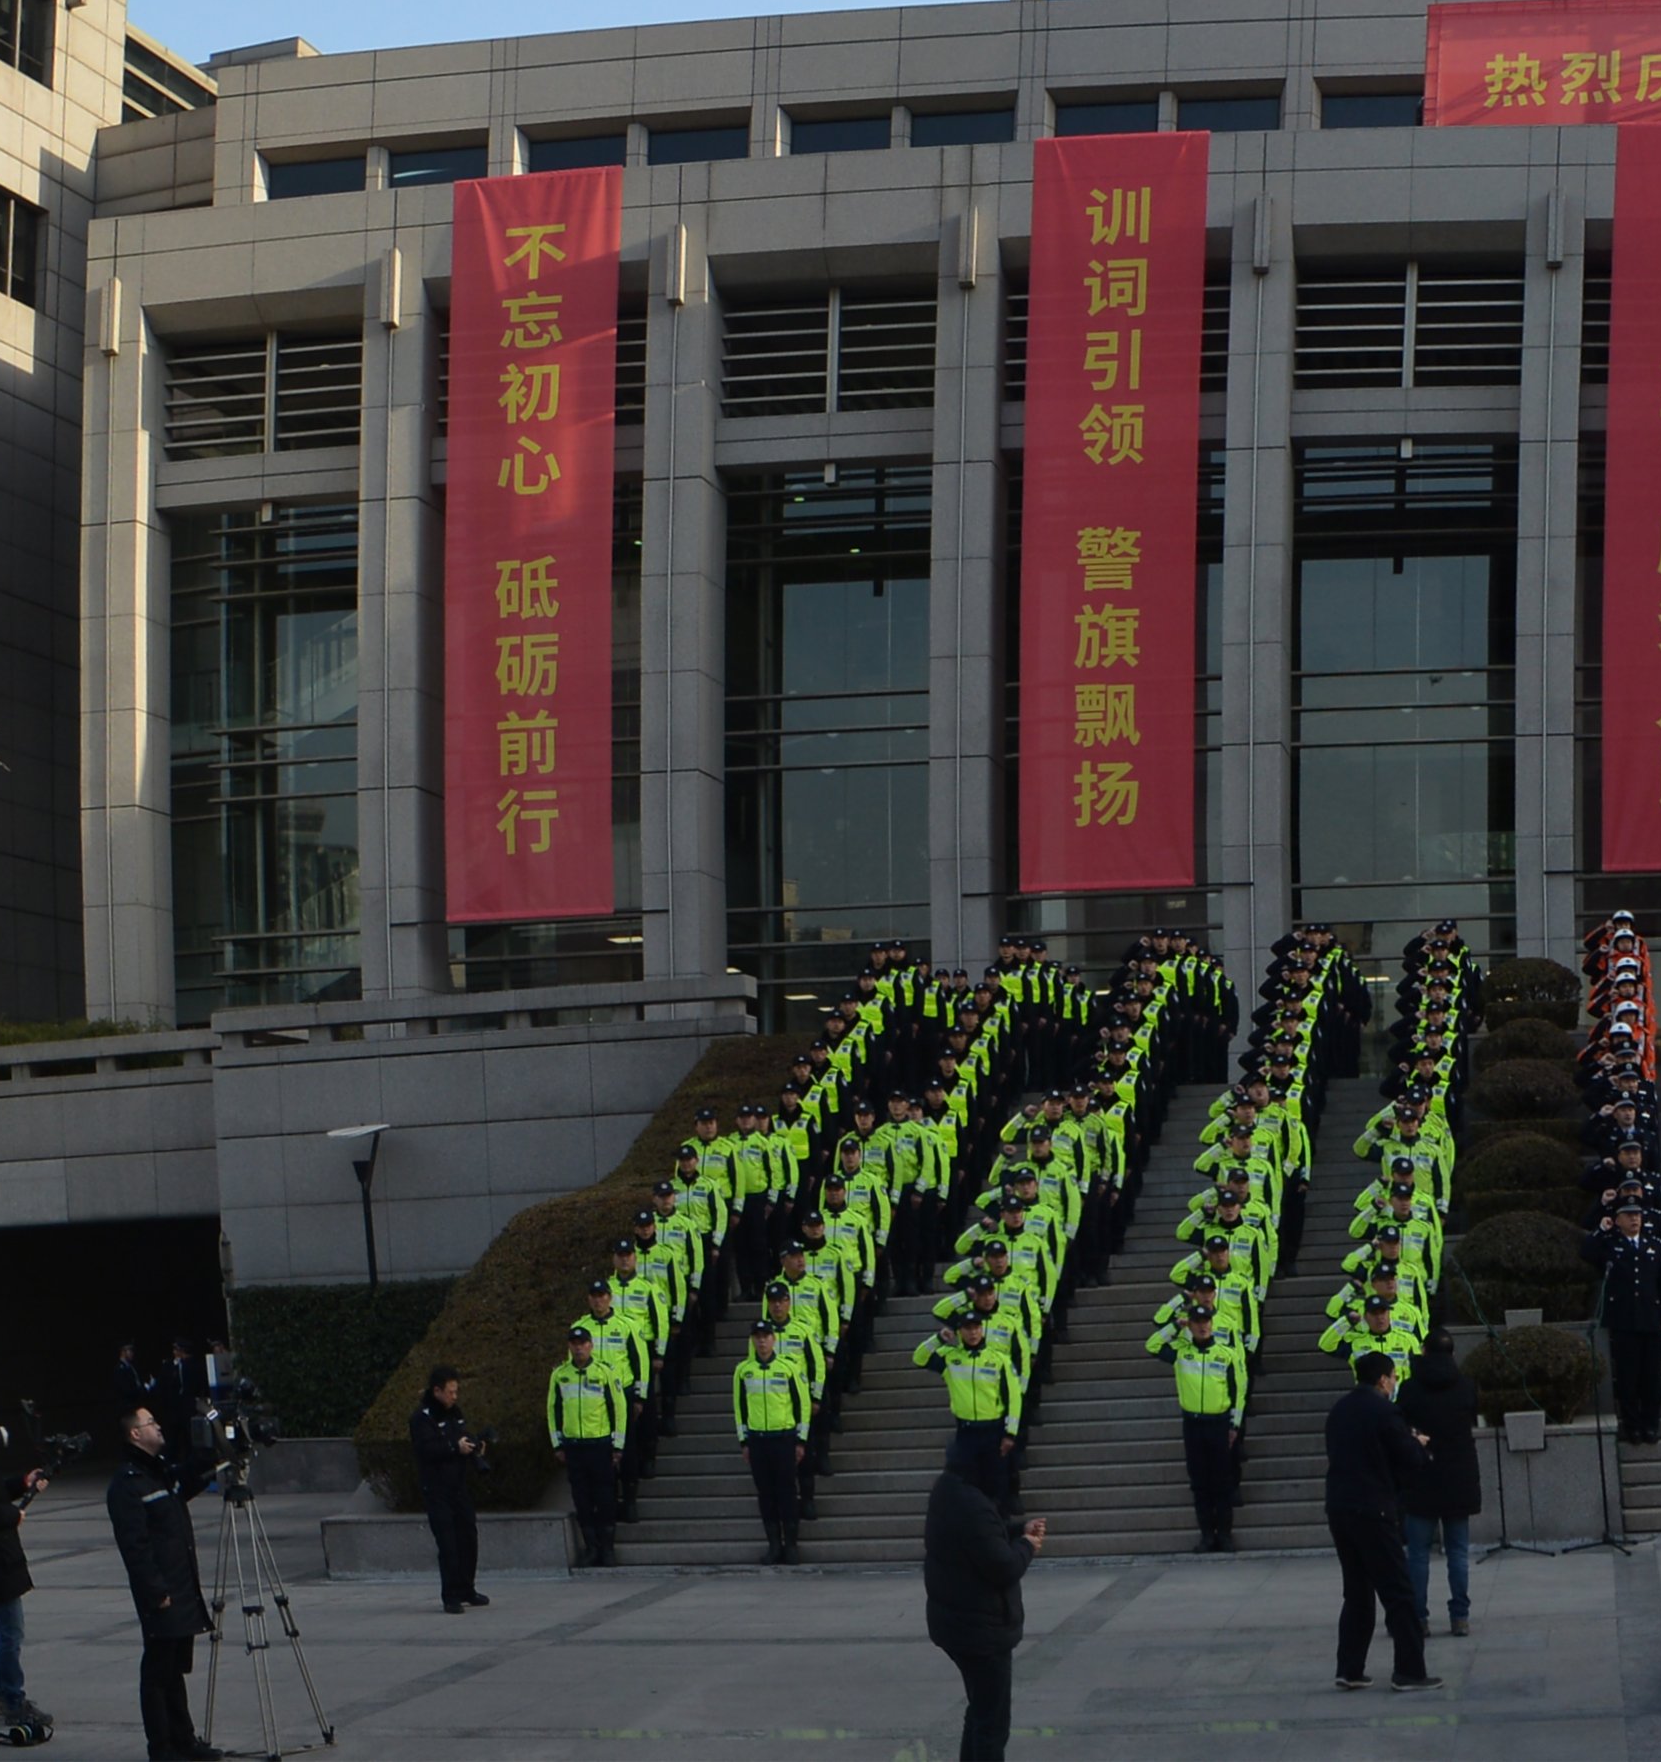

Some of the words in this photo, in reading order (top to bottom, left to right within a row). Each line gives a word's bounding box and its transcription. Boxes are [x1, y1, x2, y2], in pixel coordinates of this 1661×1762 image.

[497, 222, 568, 496] 不忘初心
[1079, 185, 1153, 466] 训词引领
[494, 555, 561, 856] 砥砺前行
[1072, 525, 1142, 828] 警旗飘扬
